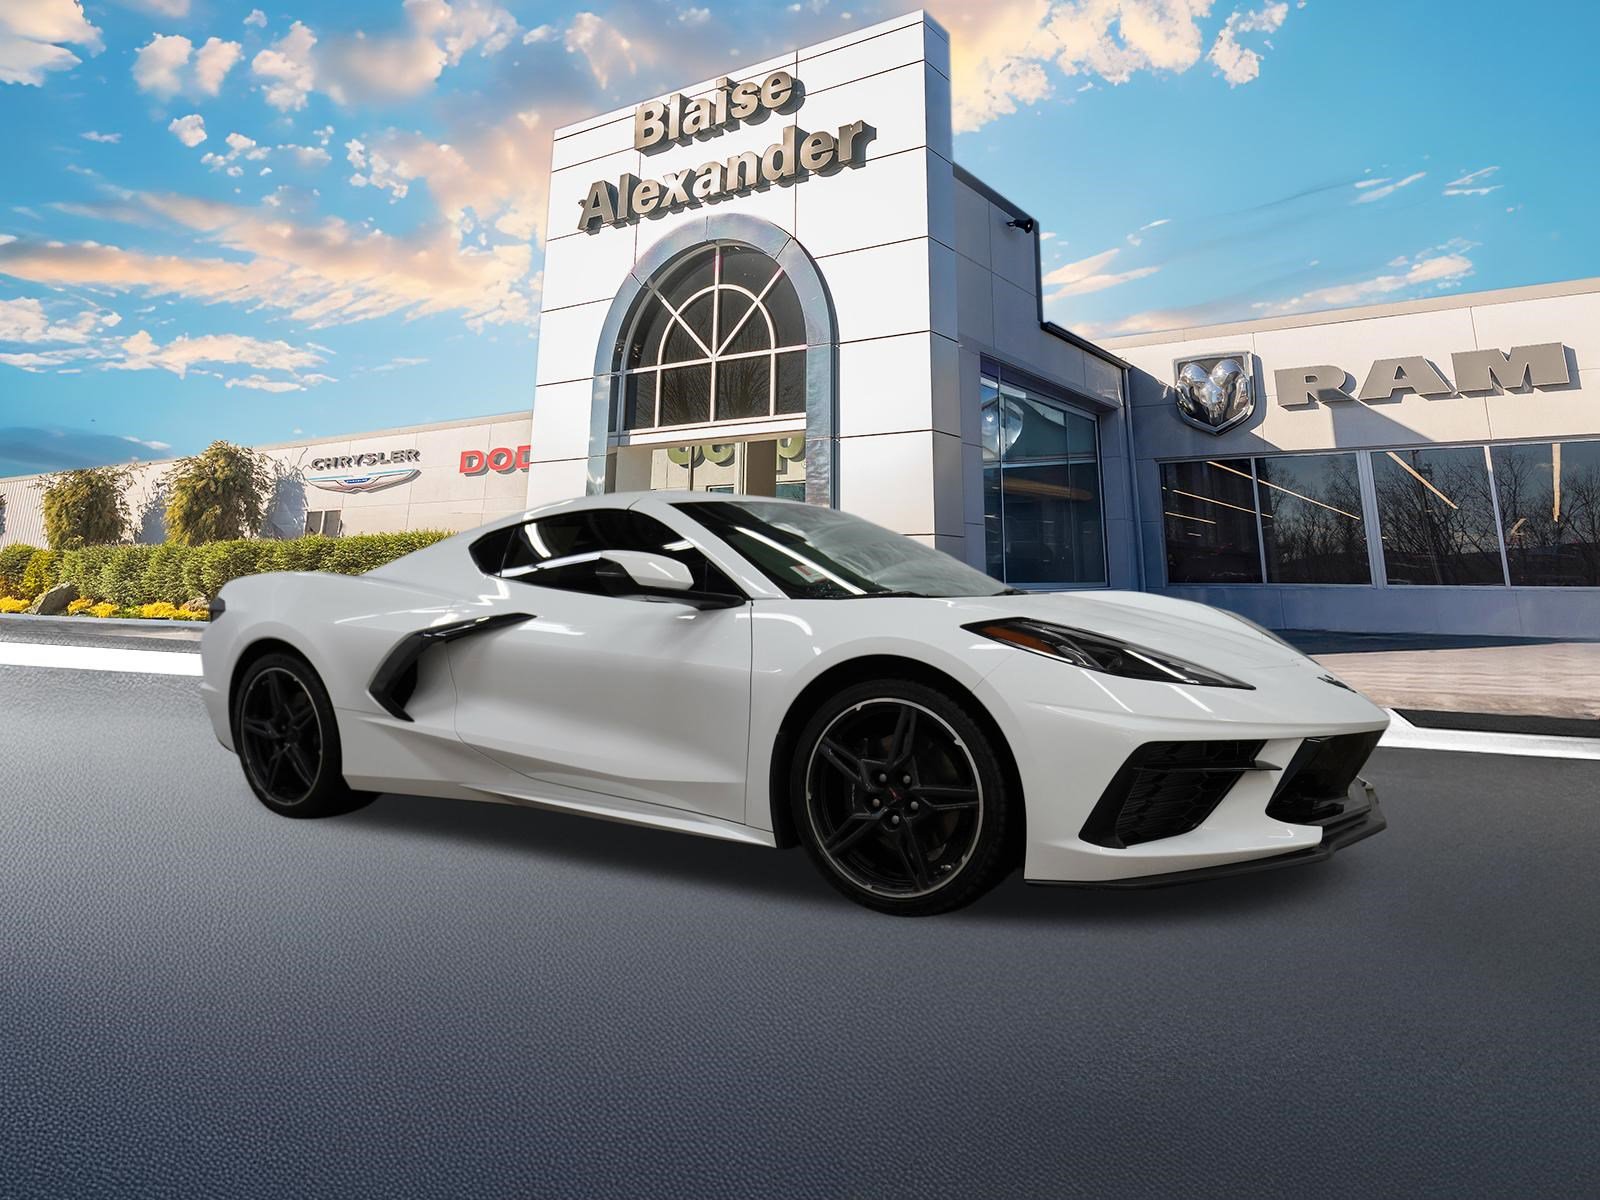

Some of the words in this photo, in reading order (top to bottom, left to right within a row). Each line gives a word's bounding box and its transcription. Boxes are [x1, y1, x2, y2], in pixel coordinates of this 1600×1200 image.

[634, 71, 800, 154] Blaise
[577, 120, 872, 233] Alexander
[1274, 341, 1571, 407] RAM
[311, 449, 420, 470] CHRYSLER
